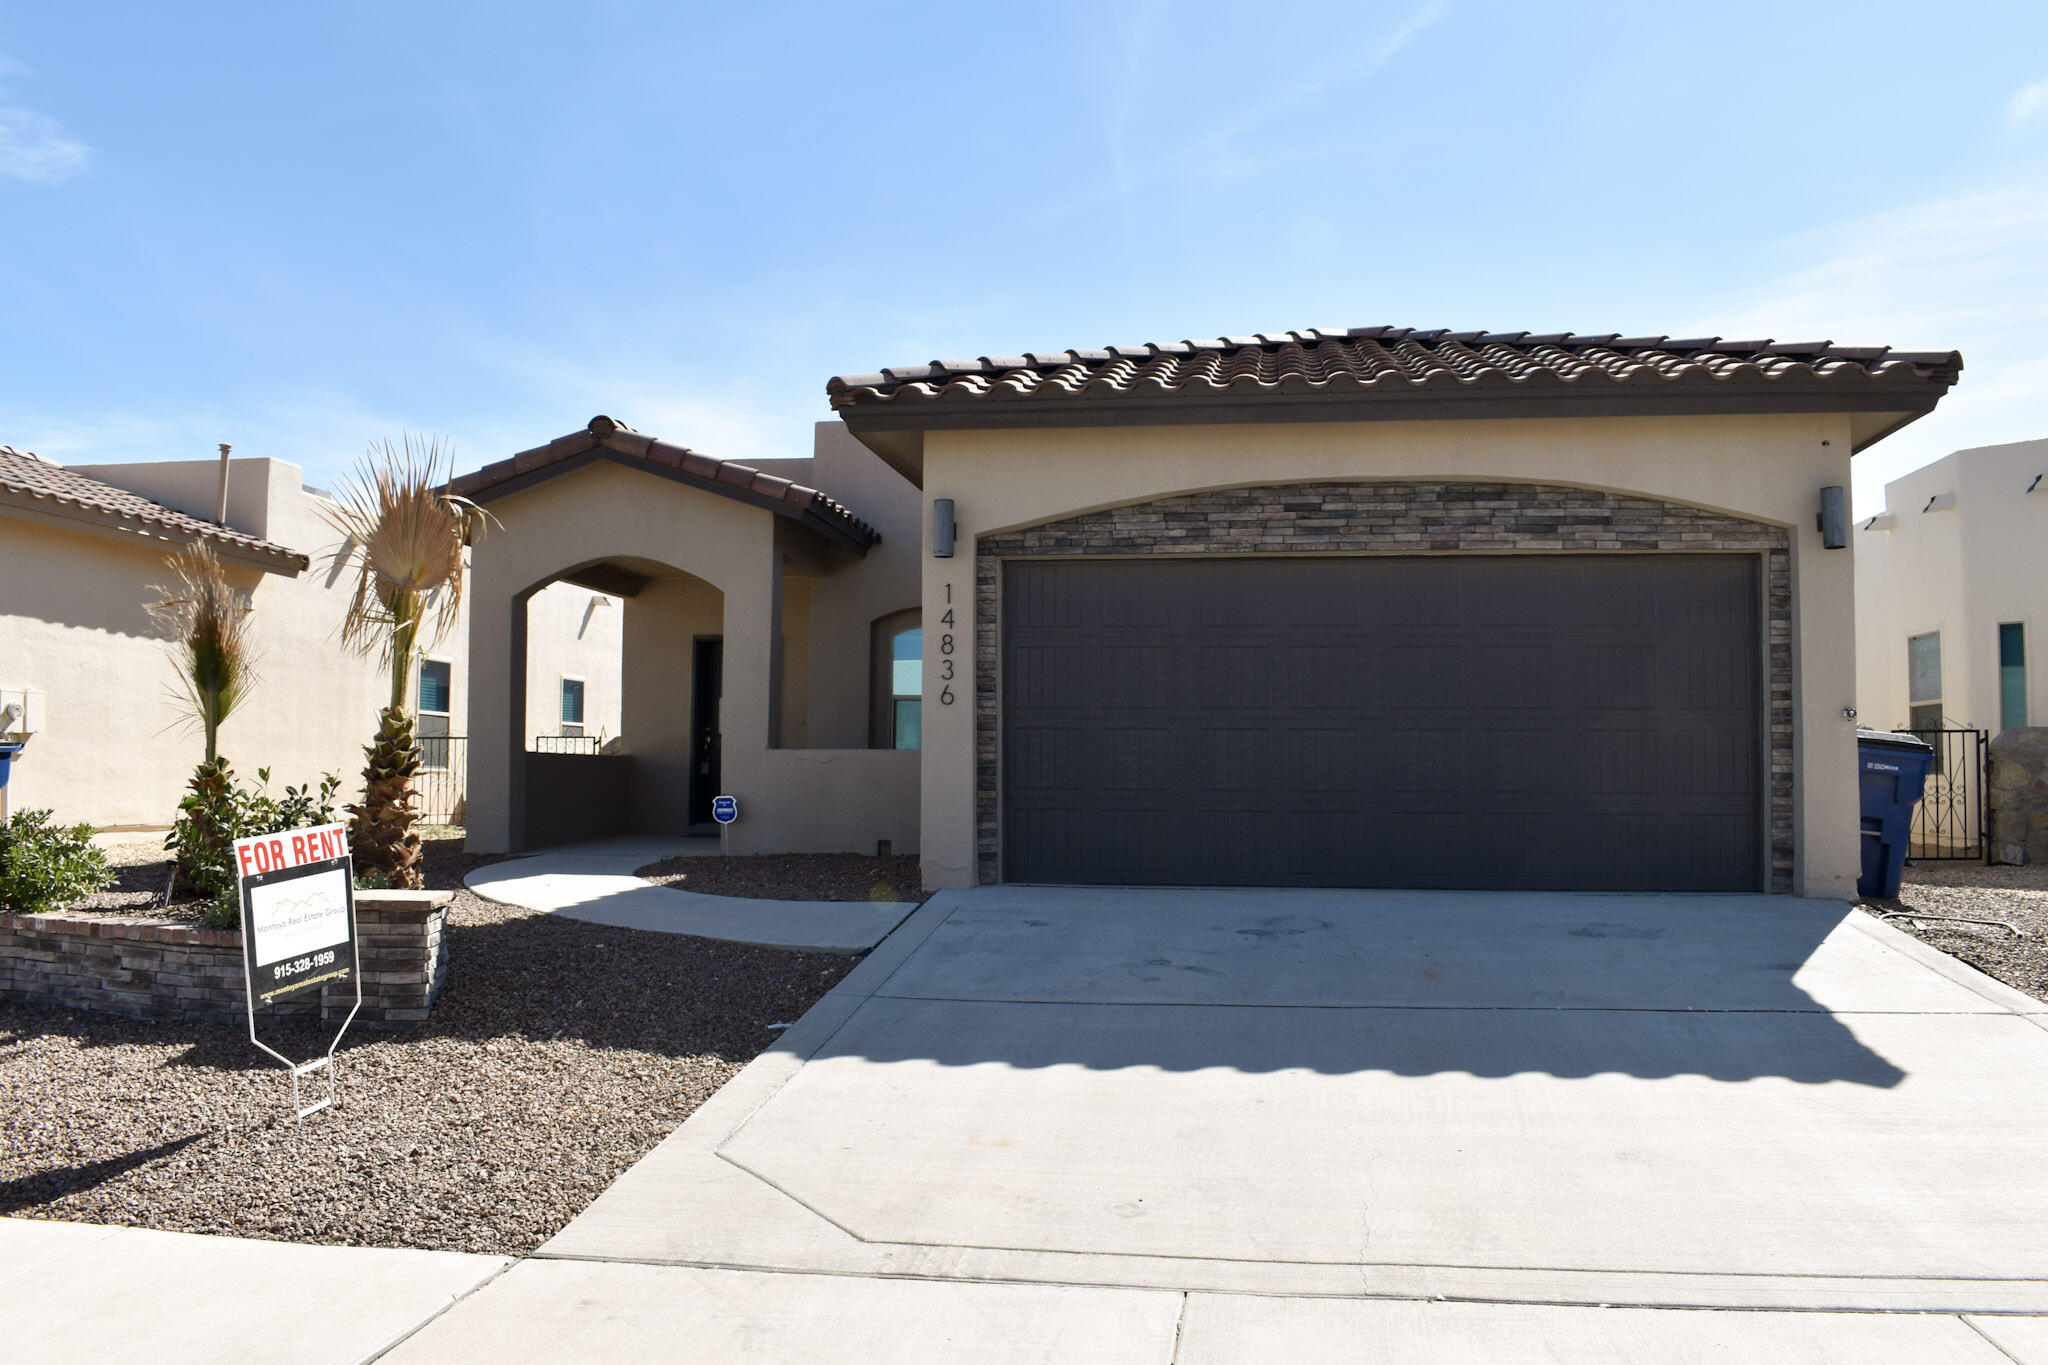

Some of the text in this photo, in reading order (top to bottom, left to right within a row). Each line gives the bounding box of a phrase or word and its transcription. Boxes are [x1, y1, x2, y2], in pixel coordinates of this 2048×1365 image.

[941, 583, 955, 706] 14836
[238, 828, 344, 876] FOR RENT
[257, 921, 287, 934] Montoya
[288, 915, 303, 925] Real
[304, 911, 323, 922] Estate
[325, 906, 346, 917] Group
[274, 950, 335, 979] 915-328-1959
[260, 967, 350, 1000] www.montoyarealestategroup.com
